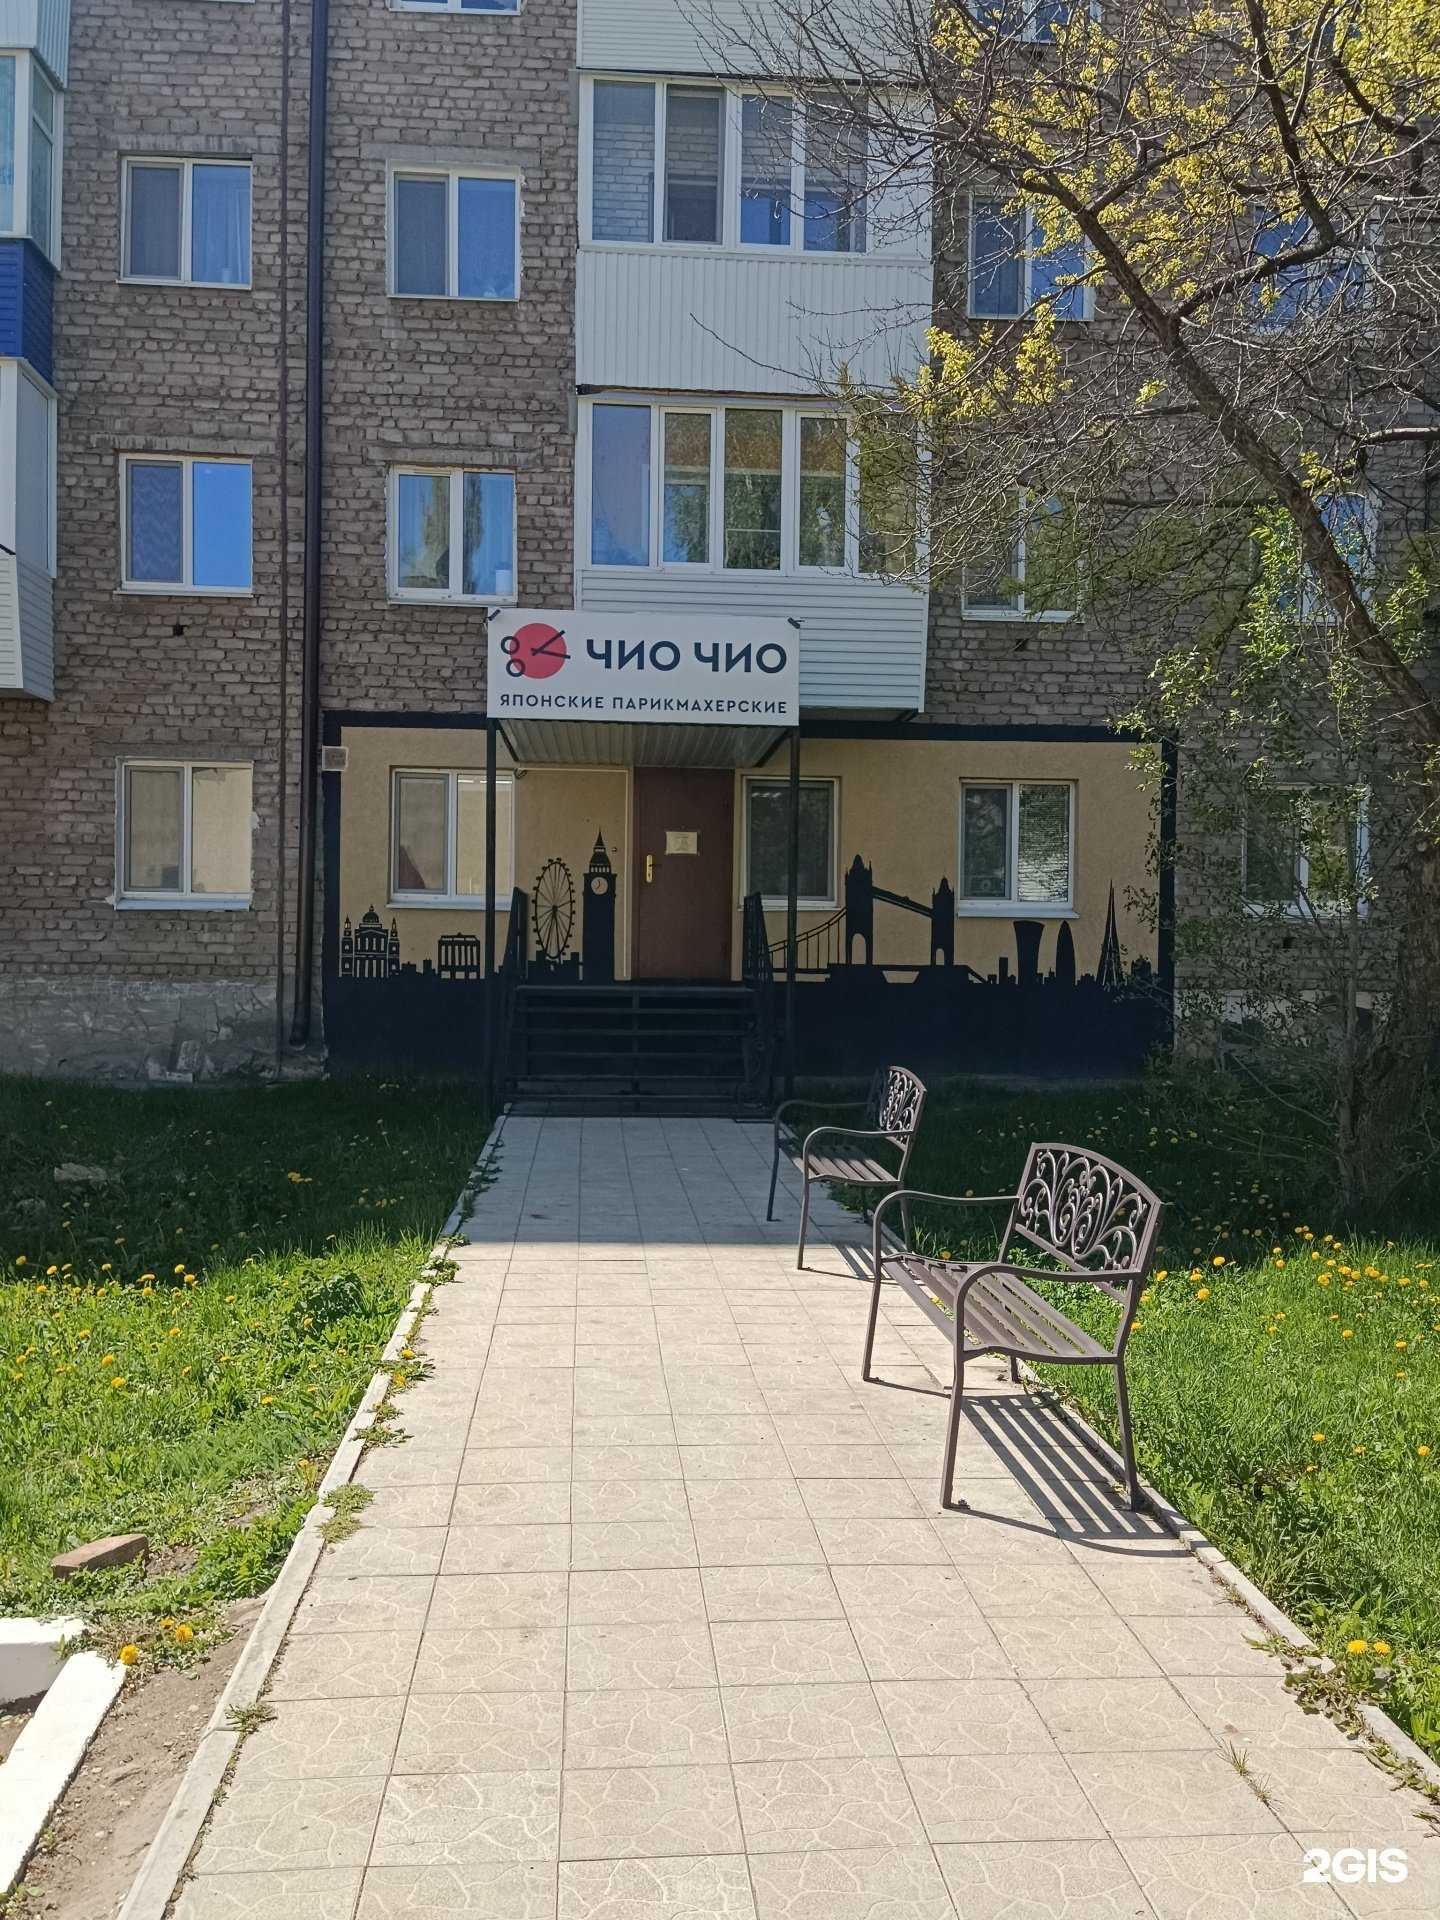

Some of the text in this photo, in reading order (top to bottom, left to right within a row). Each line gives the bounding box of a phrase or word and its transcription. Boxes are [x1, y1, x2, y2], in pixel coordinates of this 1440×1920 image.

[586, 639, 787, 674] ЧИО ЧИО
[499, 694, 787, 714] ЯПОНСКИЕ ПАРИКМАХЕРСКИЕ
